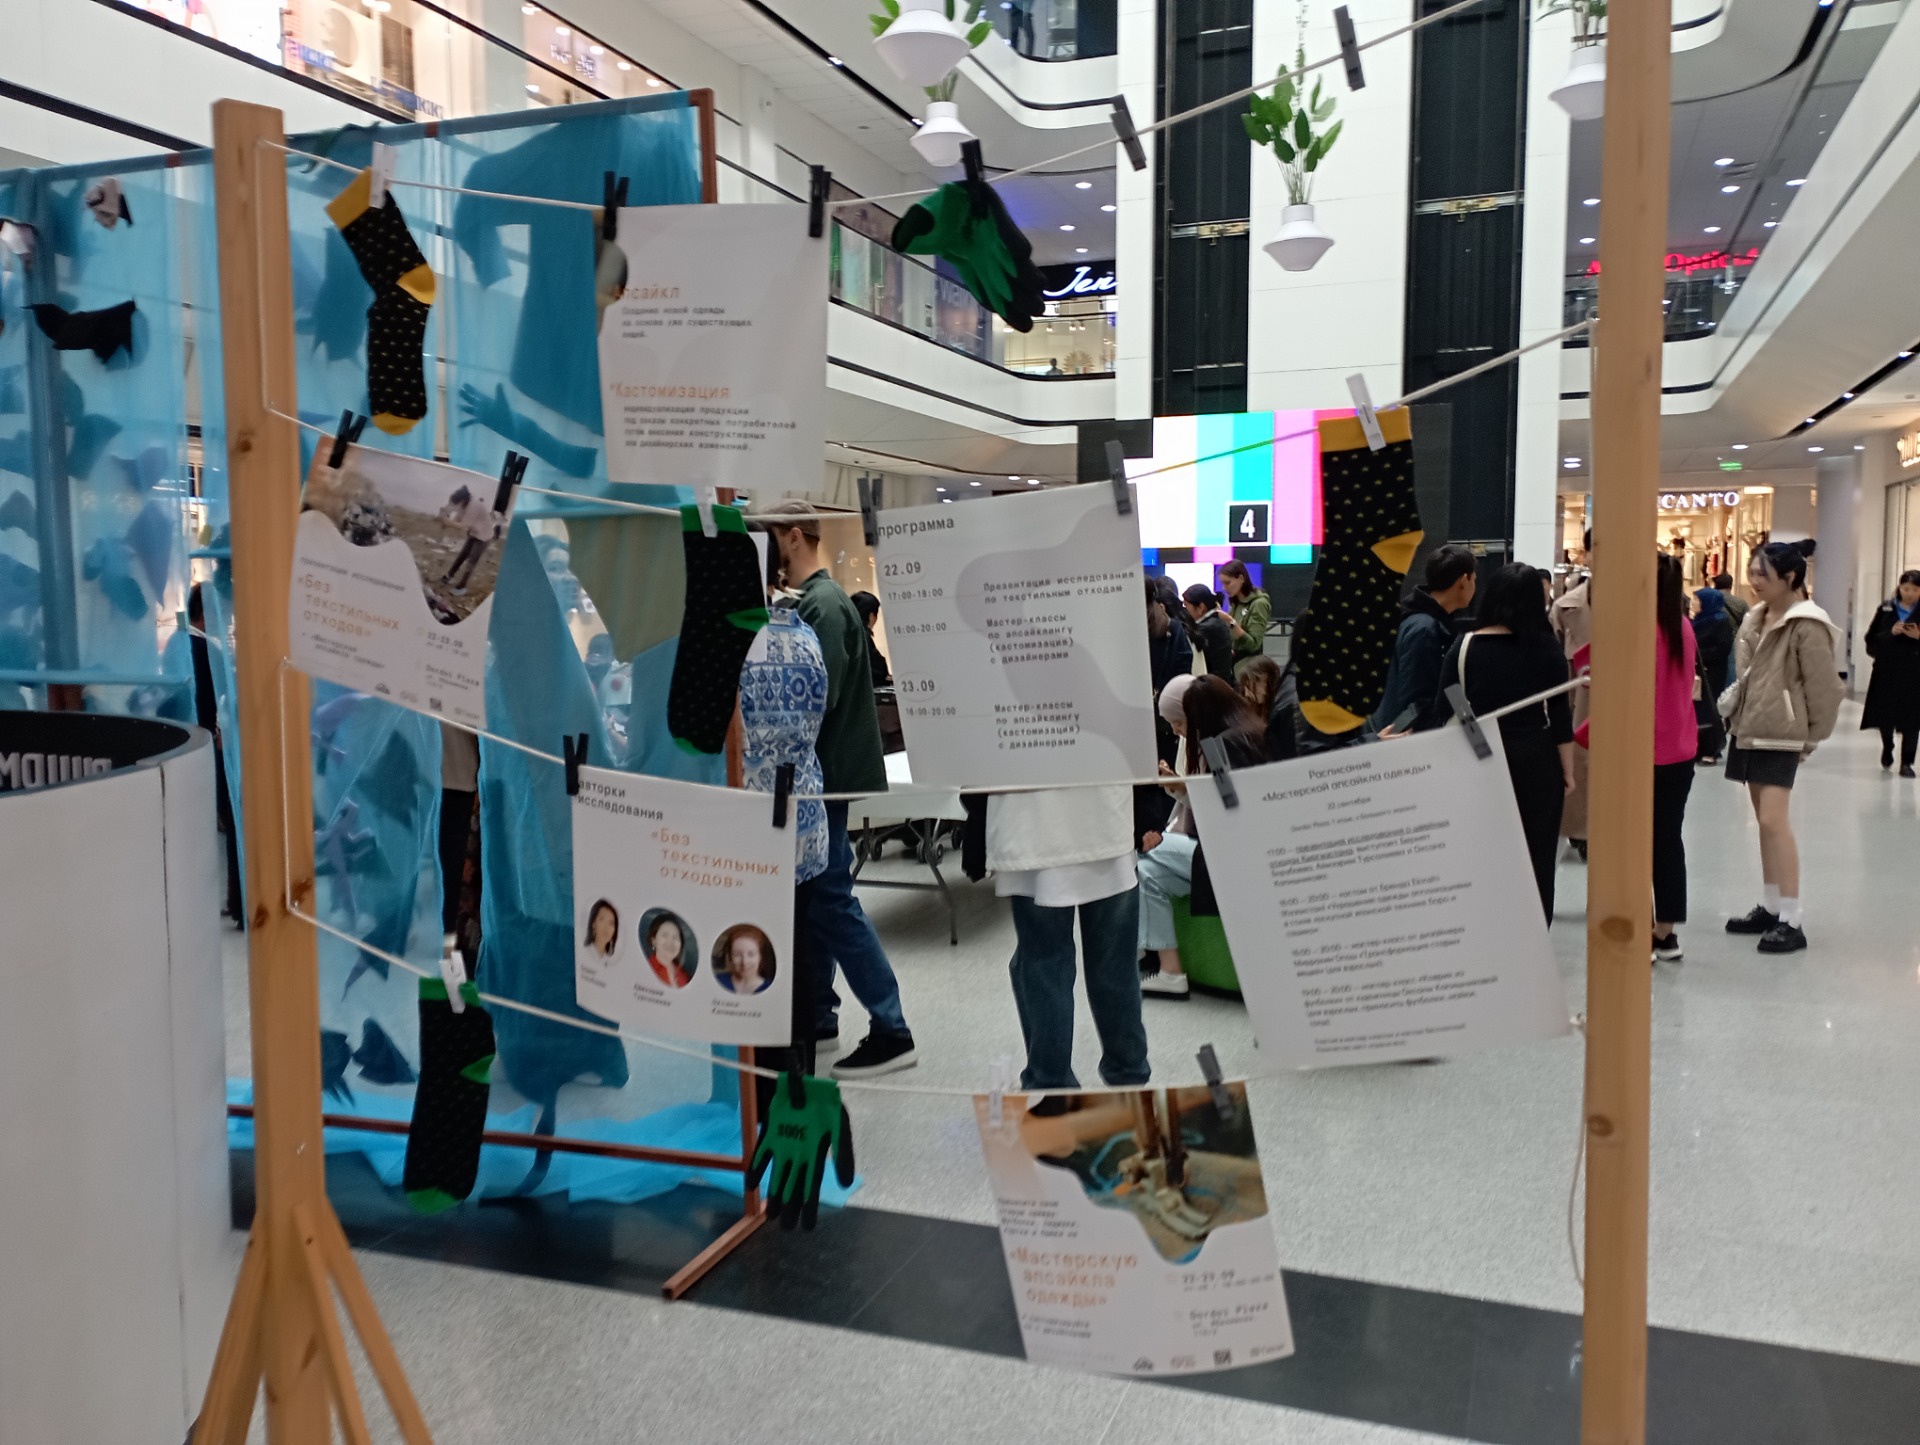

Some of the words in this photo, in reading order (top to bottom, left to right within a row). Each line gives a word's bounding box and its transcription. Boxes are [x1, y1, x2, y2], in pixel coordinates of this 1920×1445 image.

[878, 517, 955, 540] программа
[1240, 508, 1256, 539] 4
[884, 561, 922, 577] 22.09
[983, 576, 1051, 592] Презентация
[1056, 570, 1135, 585] исследования
[984, 595, 997, 605] по
[1002, 588, 1071, 602] текстильным
[1077, 583, 1123, 596] отходам
[305, 594, 400, 631] текстильных
[986, 613, 1067, 628] Мастер-классы
[988, 632, 1000, 641] по
[1005, 626, 1073, 639] апсайклингу
[989, 637, 1075, 653] (кастомизация)
[1001, 650, 1070, 665] дизайнерами
[901, 679, 935, 693] 23.09
[994, 701, 1074, 714] Мастер-классы
[1013, 712, 1080, 726] апсайклингу
[997, 724, 1081, 739] (кастомизация)
[1009, 737, 1076, 750] дизайнерами
[1308, 761, 1372, 780] Расписание
[1262, 783, 1330, 802] «Мастерской
[1331, 774, 1382, 791] апсайкла
[1383, 764, 1432, 780] одежды»
[577, 795, 664, 820] исследования
[651, 828, 691, 847] «Без
[660, 849, 780, 876] текстильных
[659, 866, 744, 889] отходов»
[1008, 1246, 1138, 1272] «Мастерскую
